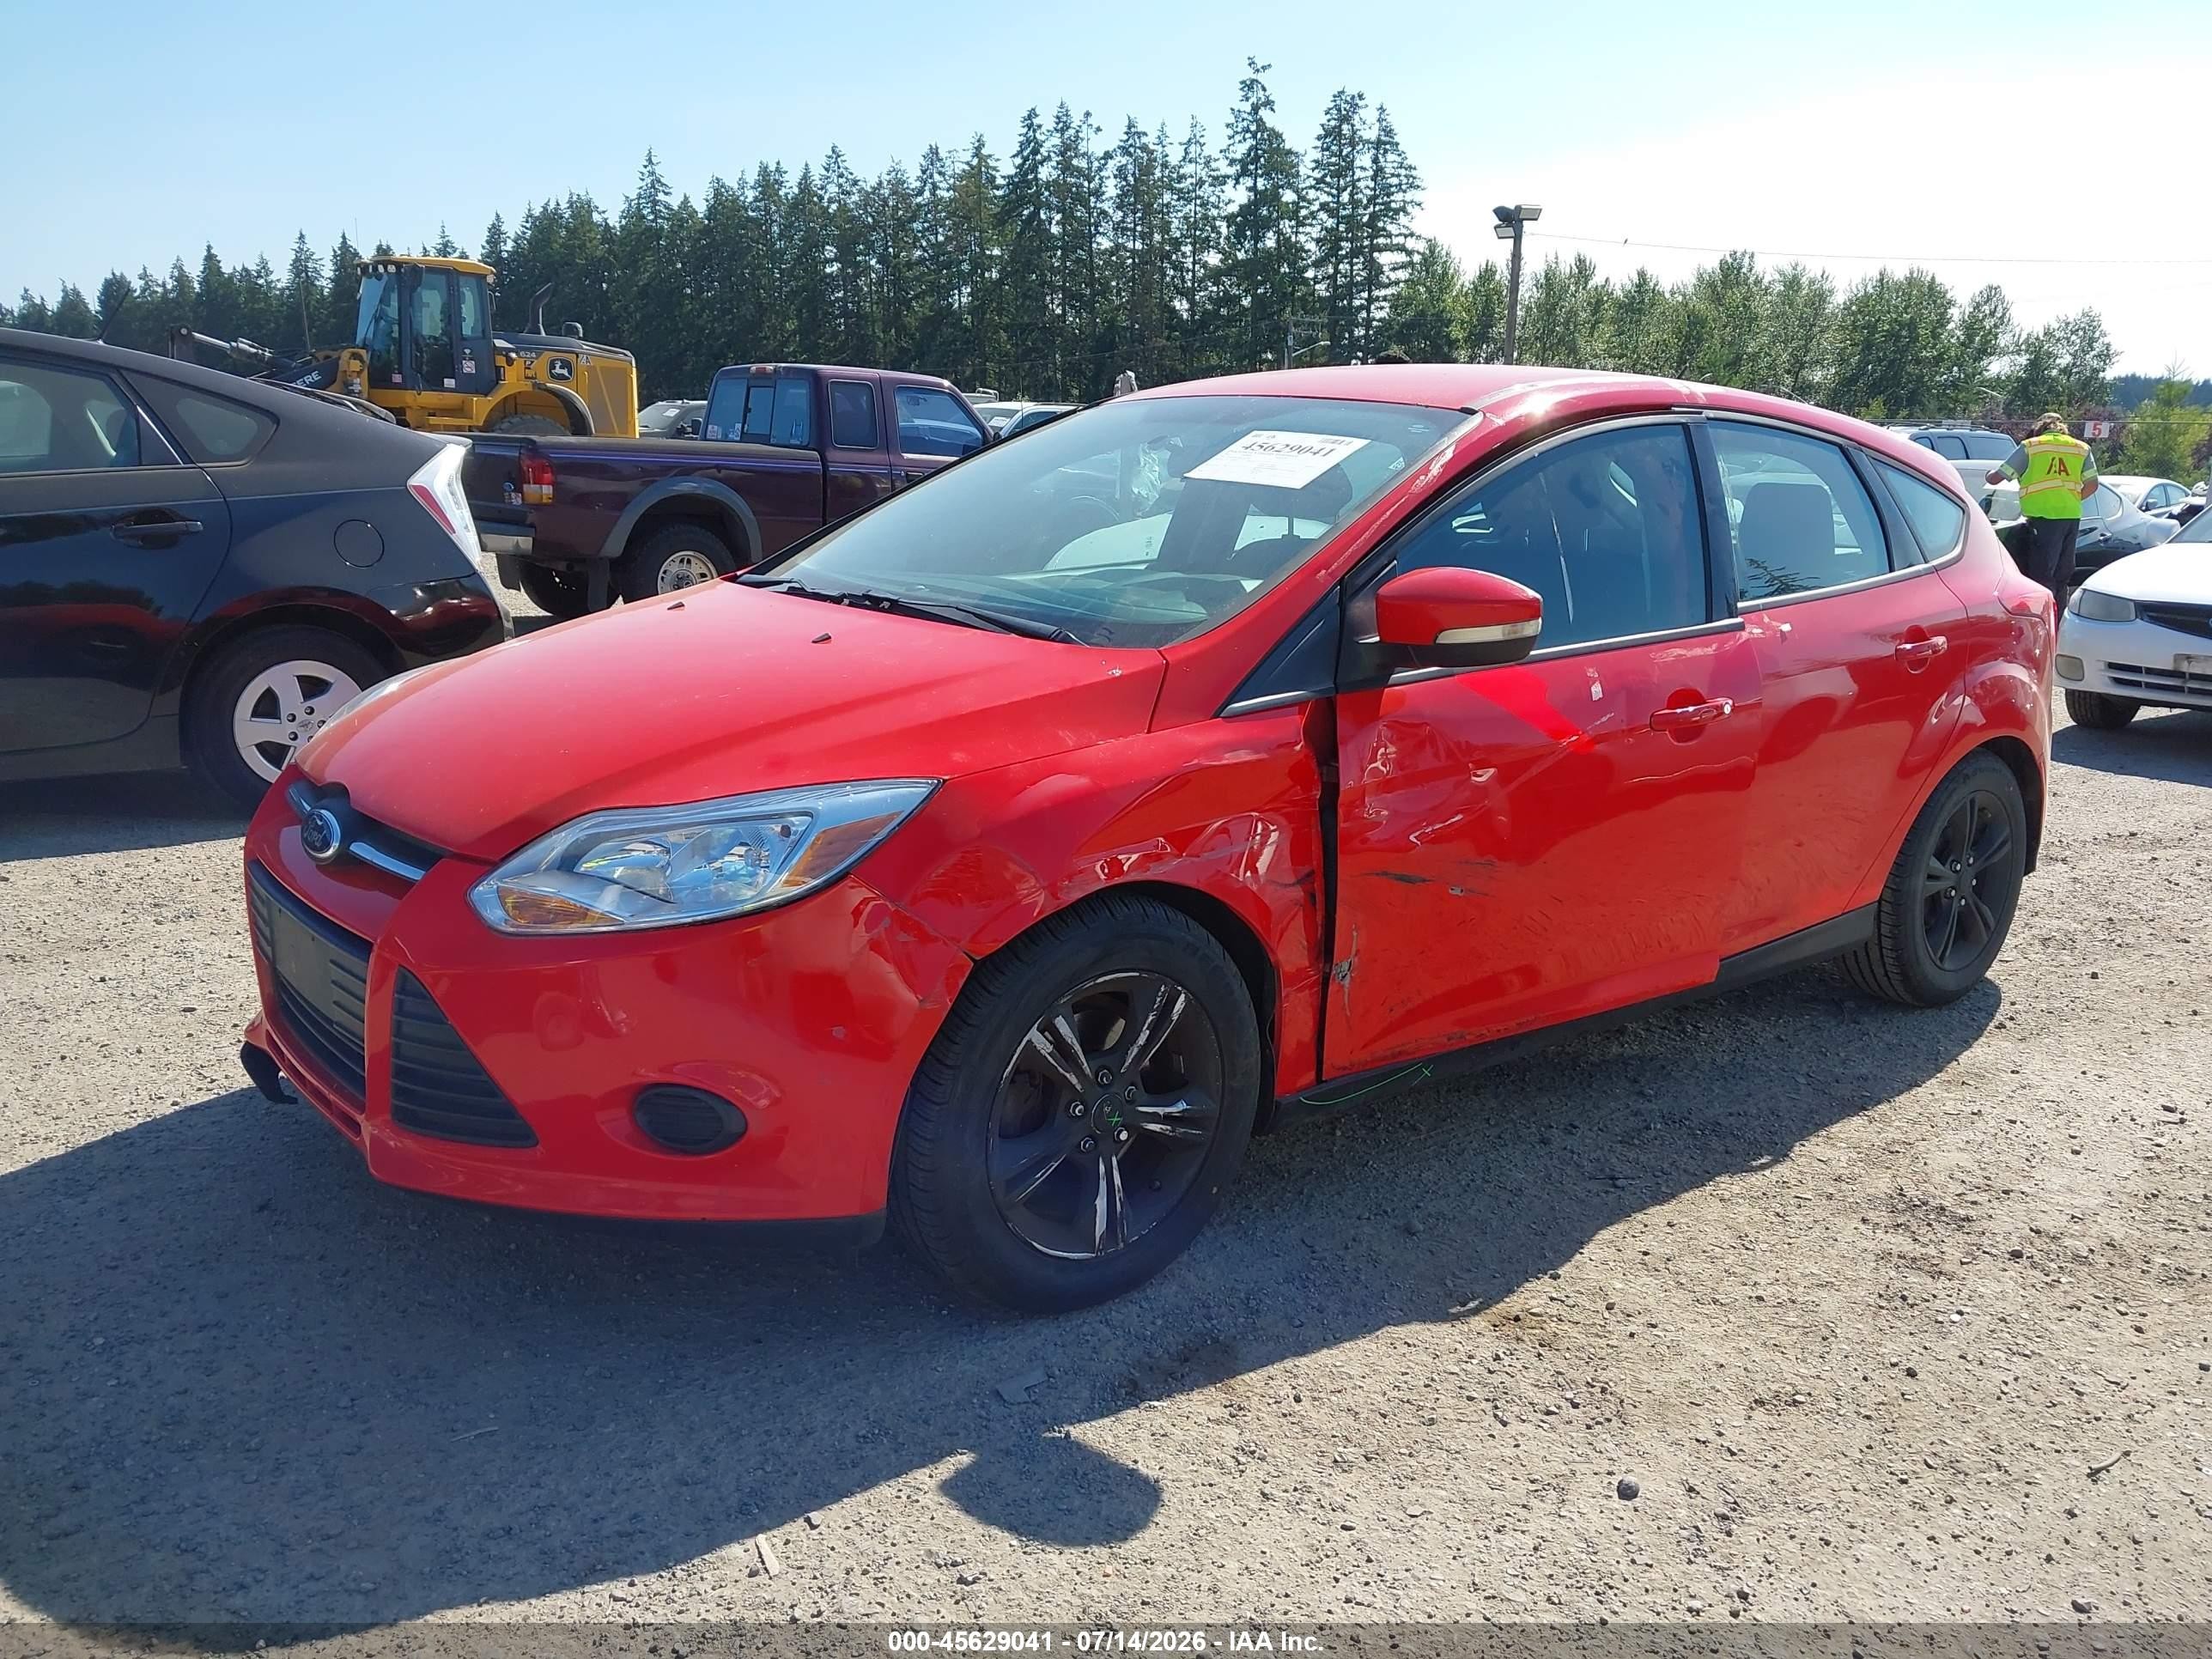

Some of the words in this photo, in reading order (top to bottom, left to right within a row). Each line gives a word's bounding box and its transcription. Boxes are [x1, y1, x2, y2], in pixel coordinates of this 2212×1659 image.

[293, 370, 323, 386] ERE
[2092, 421, 2102, 437] 5
[1242, 441, 1335, 457] 45629041
